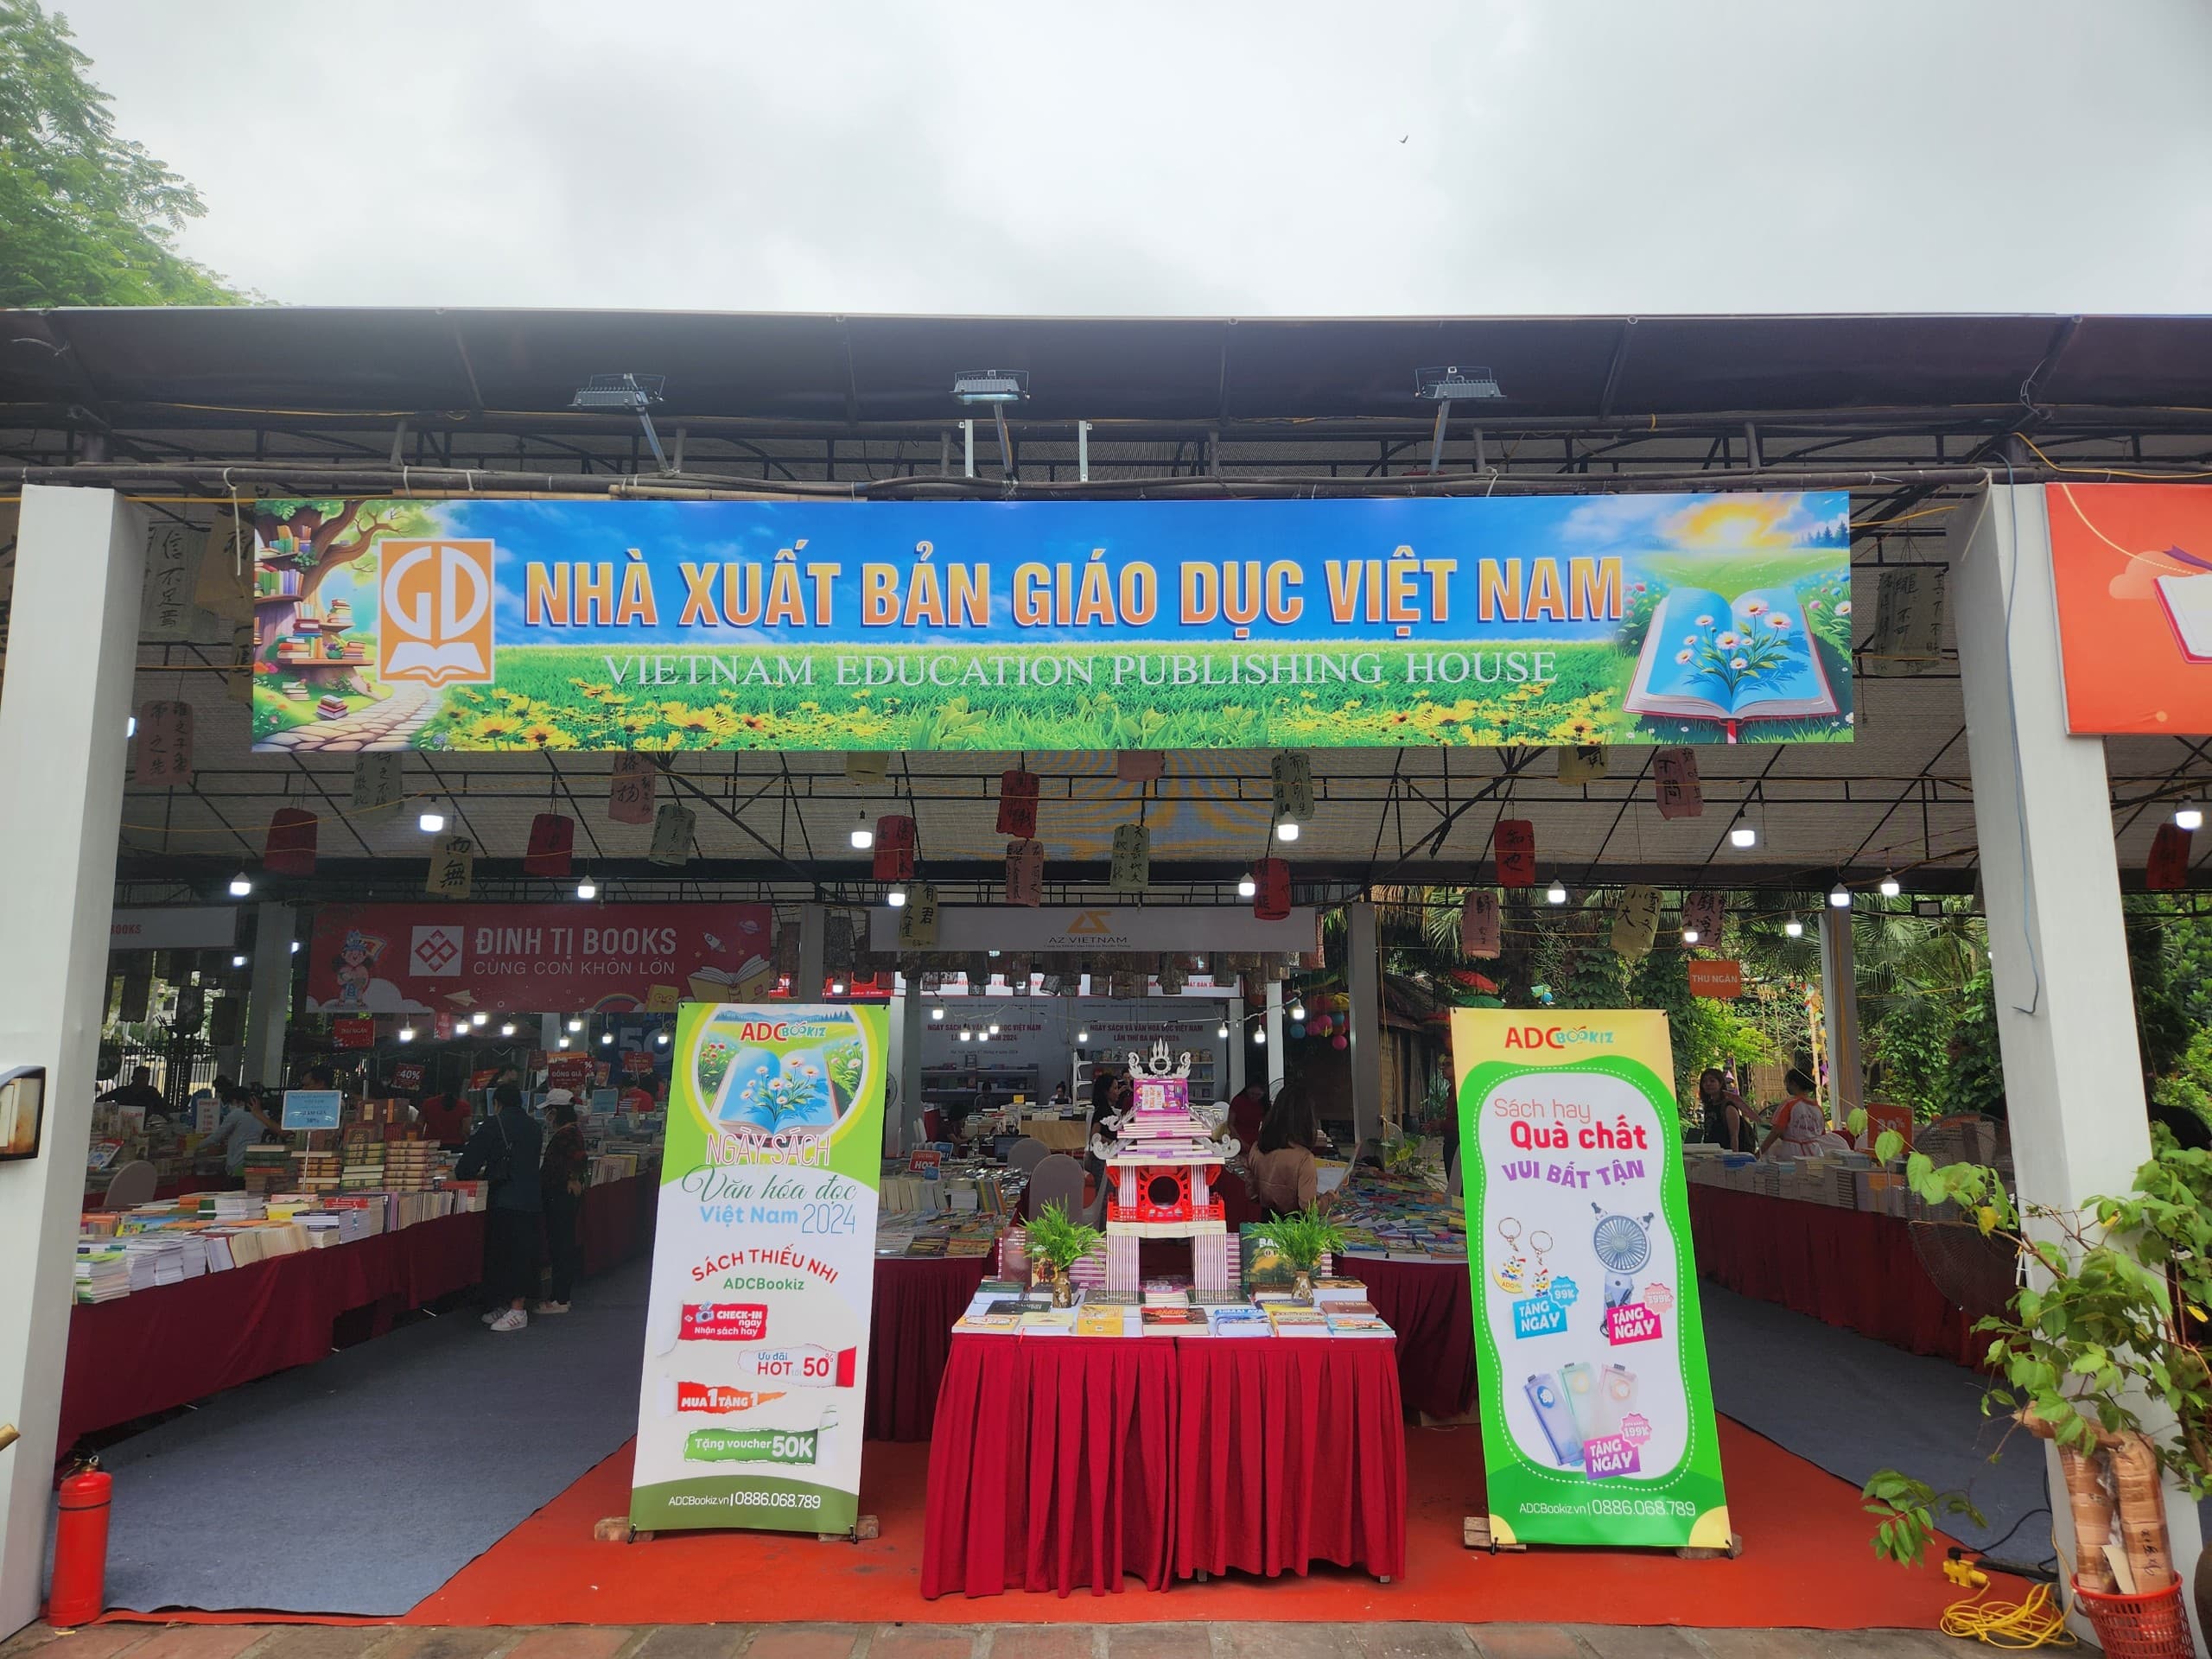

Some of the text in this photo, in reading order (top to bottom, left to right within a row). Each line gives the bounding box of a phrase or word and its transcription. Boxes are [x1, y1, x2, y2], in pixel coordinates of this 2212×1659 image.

[525, 539, 1624, 640] NHÀ XUẤT BẢN GIÁO DỤC VIỆT NAM
[605, 652, 1558, 688] VIETNAM EDUCATION PUBLISHING HOUSE
[476, 927, 677, 959] ĐINH TỊ BOOKS
[473, 956, 676, 976] CÙNG CON KHÔN LỚN
[1712, 973, 1738, 982] NGÂN
[1494, 1097, 1592, 1123] Sách hay
[1510, 1115, 1649, 1151] Quà chất
[706, 1126, 830, 1166] NGÀY SÁCH
[681, 1164, 857, 1205] Văn hóa đọc
[1501, 1159, 1646, 1190] VUI BẤT TẬN
[699, 1203, 856, 1235] Việt Nam 2024
[691, 1243, 839, 1284] SÁCH THIẾU NHI
[723, 1277, 804, 1291] ADCBookiz
[716, 1310, 763, 1320] CHECK-IN
[1519, 1300, 1550, 1319] TẶNG
[1612, 1306, 1644, 1325] TẶNG
[694, 1326, 758, 1338] Nhận sách hay
[738, 1319, 762, 1328] ngay
[1521, 1312, 1560, 1332] NGAY
[1615, 1319, 1656, 1339] NGAY
[772, 1351, 788, 1361] đãi
[757, 1361, 793, 1376] HOT
[681, 1388, 759, 1409] MUA 1 TẶNG 1
[695, 1435, 815, 1458] Tặng voucher 50K
[1590, 1439, 1622, 1458] TẶNG
[1592, 1450, 1633, 1473] NGAY
[735, 1491, 821, 1509] 0886.068.789
[1592, 1498, 1696, 1516] 0886.068.789
